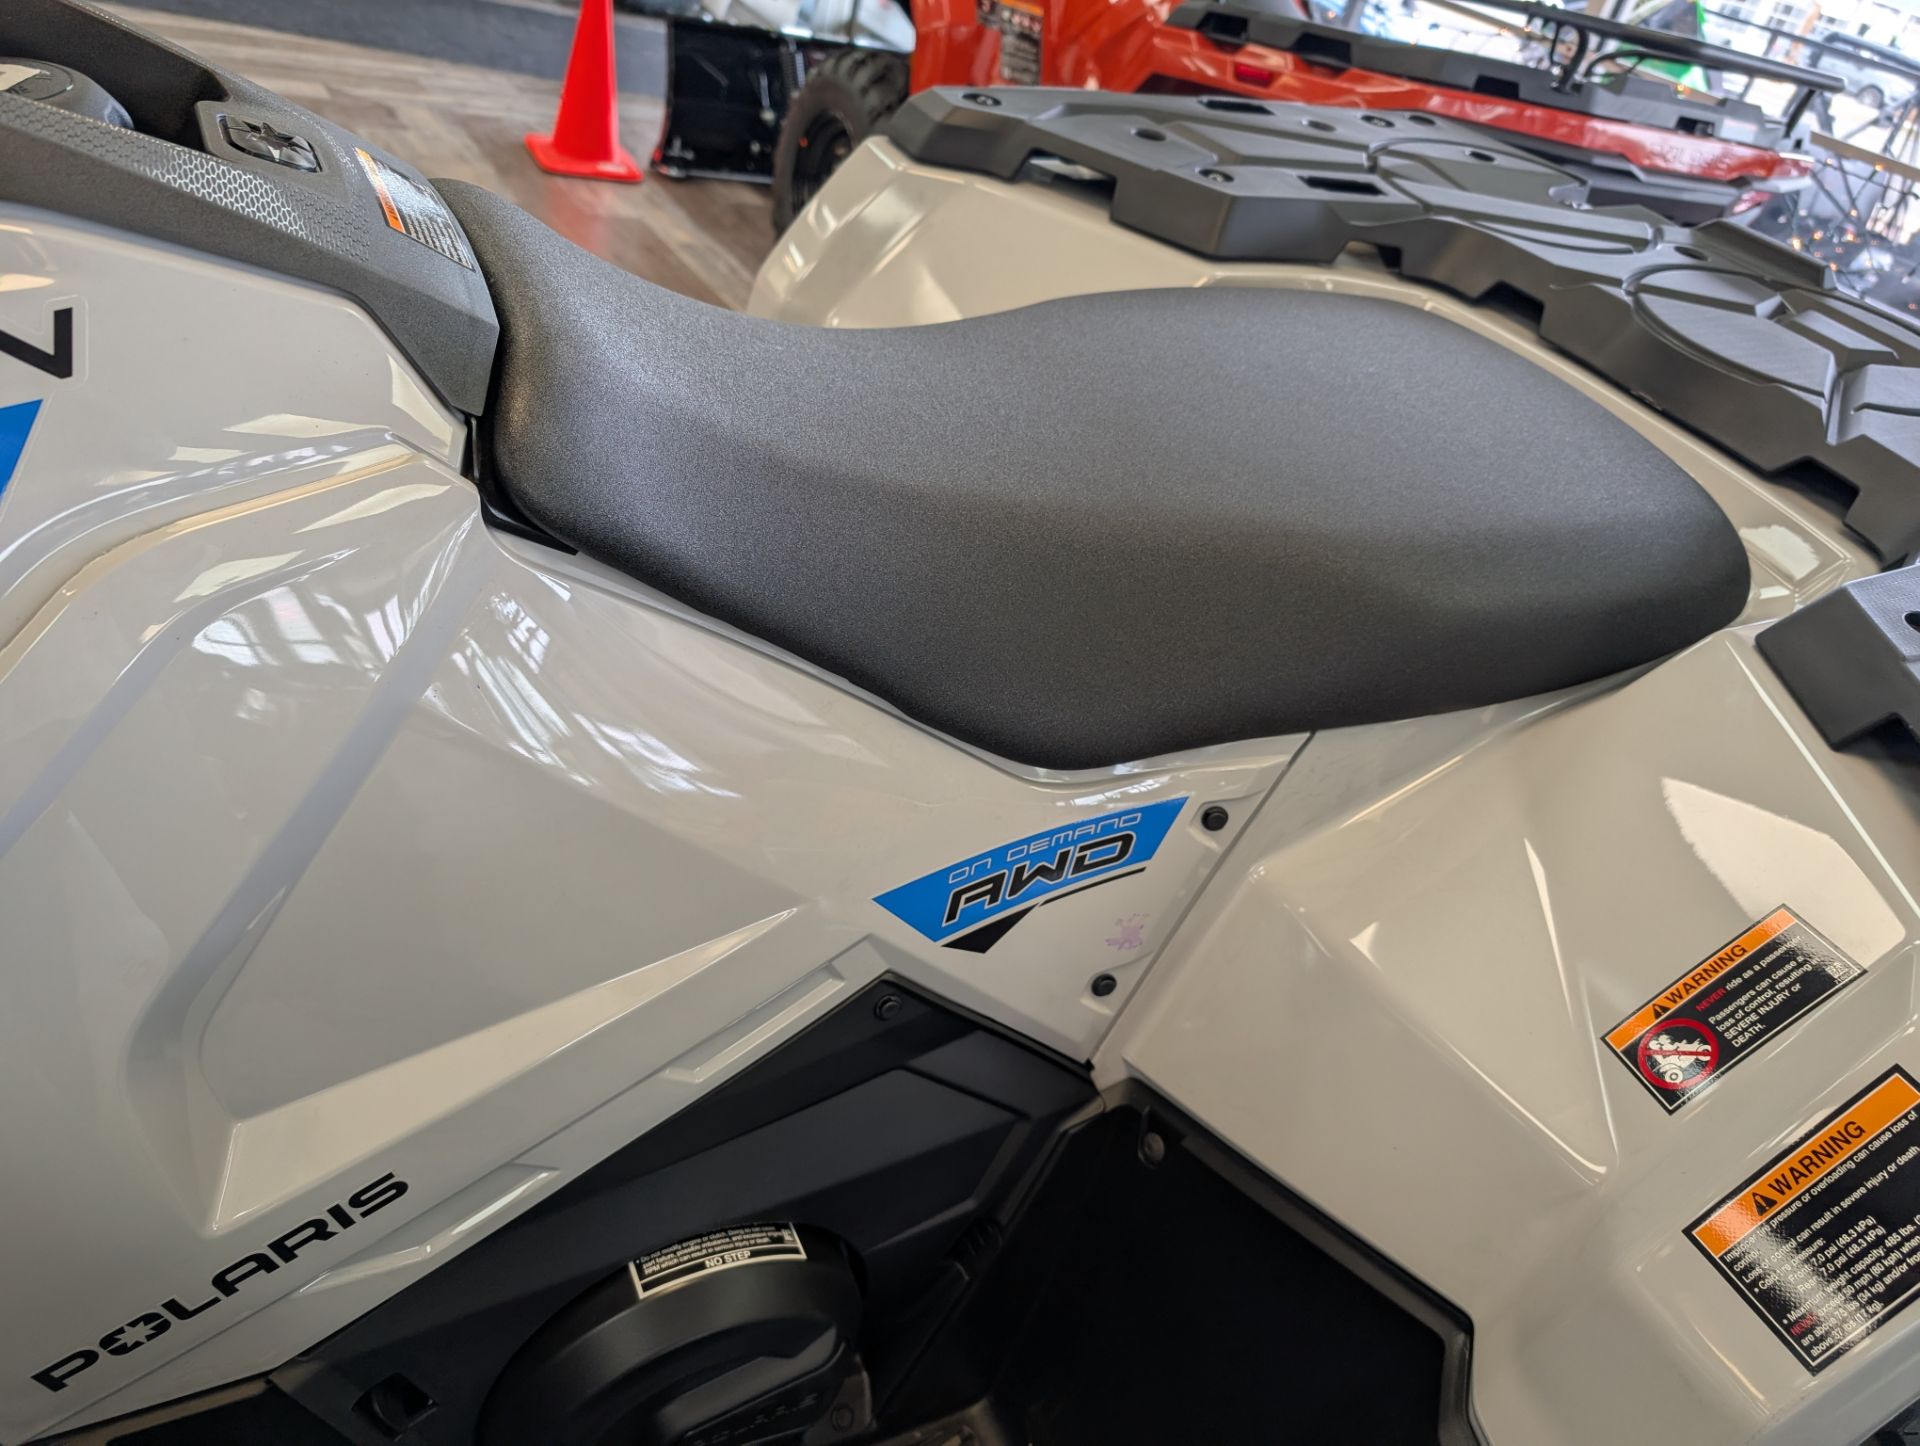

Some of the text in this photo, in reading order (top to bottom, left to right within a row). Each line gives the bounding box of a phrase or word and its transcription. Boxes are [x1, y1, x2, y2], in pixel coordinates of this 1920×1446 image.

[941, 832, 1137, 927] AWD
[949, 813, 1142, 883] ON DEMAND
[1666, 944, 1747, 1004] WARNING
[1695, 988, 1725, 1010] NEVER
[1725, 977, 1742, 990] ride
[1742, 969, 1753, 978] as
[1708, 989, 1756, 1024] Passengers
[1755, 978, 1771, 990] can
[1771, 960, 1796, 979] cause
[1715, 1017, 1735, 1031] loss
[1734, 1009, 1744, 1018] of
[1744, 989, 1776, 1011] control,
[1775, 963, 1812, 989] resulting
[1724, 983, 1800, 1039] SEVERE INJURY or
[1731, 1023, 1765, 1047] DEATH.
[1769, 1121, 1865, 1195] WARNING
[1769, 1200, 1802, 1228] pressure
[1801, 1192, 1810, 1201] or
[1810, 1160, 1855, 1195] overloading
[1853, 1149, 1869, 1161] can
[1868, 1131, 1892, 1150] cause
[1889, 1118, 1908, 1133] loss
[1907, 1109, 1917, 1120] of
[1742, 1264, 1763, 1282] Loss
[1796, 1228, 1811, 1241] can
[1810, 1211, 1833, 1230] result
[1830, 1206, 1841, 1214] in
[1840, 1186, 1866, 1207] severe
[1863, 1169, 1888, 1188] injury
[1887, 1162, 1896, 1171] or
[1789, 1237, 1825, 1267] pressure:
[1809, 1253, 1825, 1267] 7.0
[1824, 1243, 1838, 1258] psi
[1835, 1229, 1857, 1248] (48.3
[1854, 1215, 1876, 1232] kPa)
[1818, 1263, 1834, 1276] 7.0
[1833, 1253, 1847, 1268] psi
[1845, 1238, 1866, 1257] (48.3
[1863, 1225, 1886, 1242] kPa)
[30, 1172, 409, 1392] POLARIS
[704, 1250, 751, 1268] NO STEP
[1822, 1271, 1851, 1295] weight
[1850, 1245, 1886, 1274] capacity:
[1884, 1232, 1901, 1246] 485
[1898, 1224, 1916, 1236] lbs.
[1853, 1273, 1872, 1288] mph
[1869, 1262, 1884, 1276] (80
[1881, 1249, 1902, 1266] kph)
[1801, 1334, 1814, 1345] are
[1856, 1289, 1871, 1304] (34
[1868, 1280, 1885, 1293] kg)
[1882, 1262, 1908, 1284] and/or
